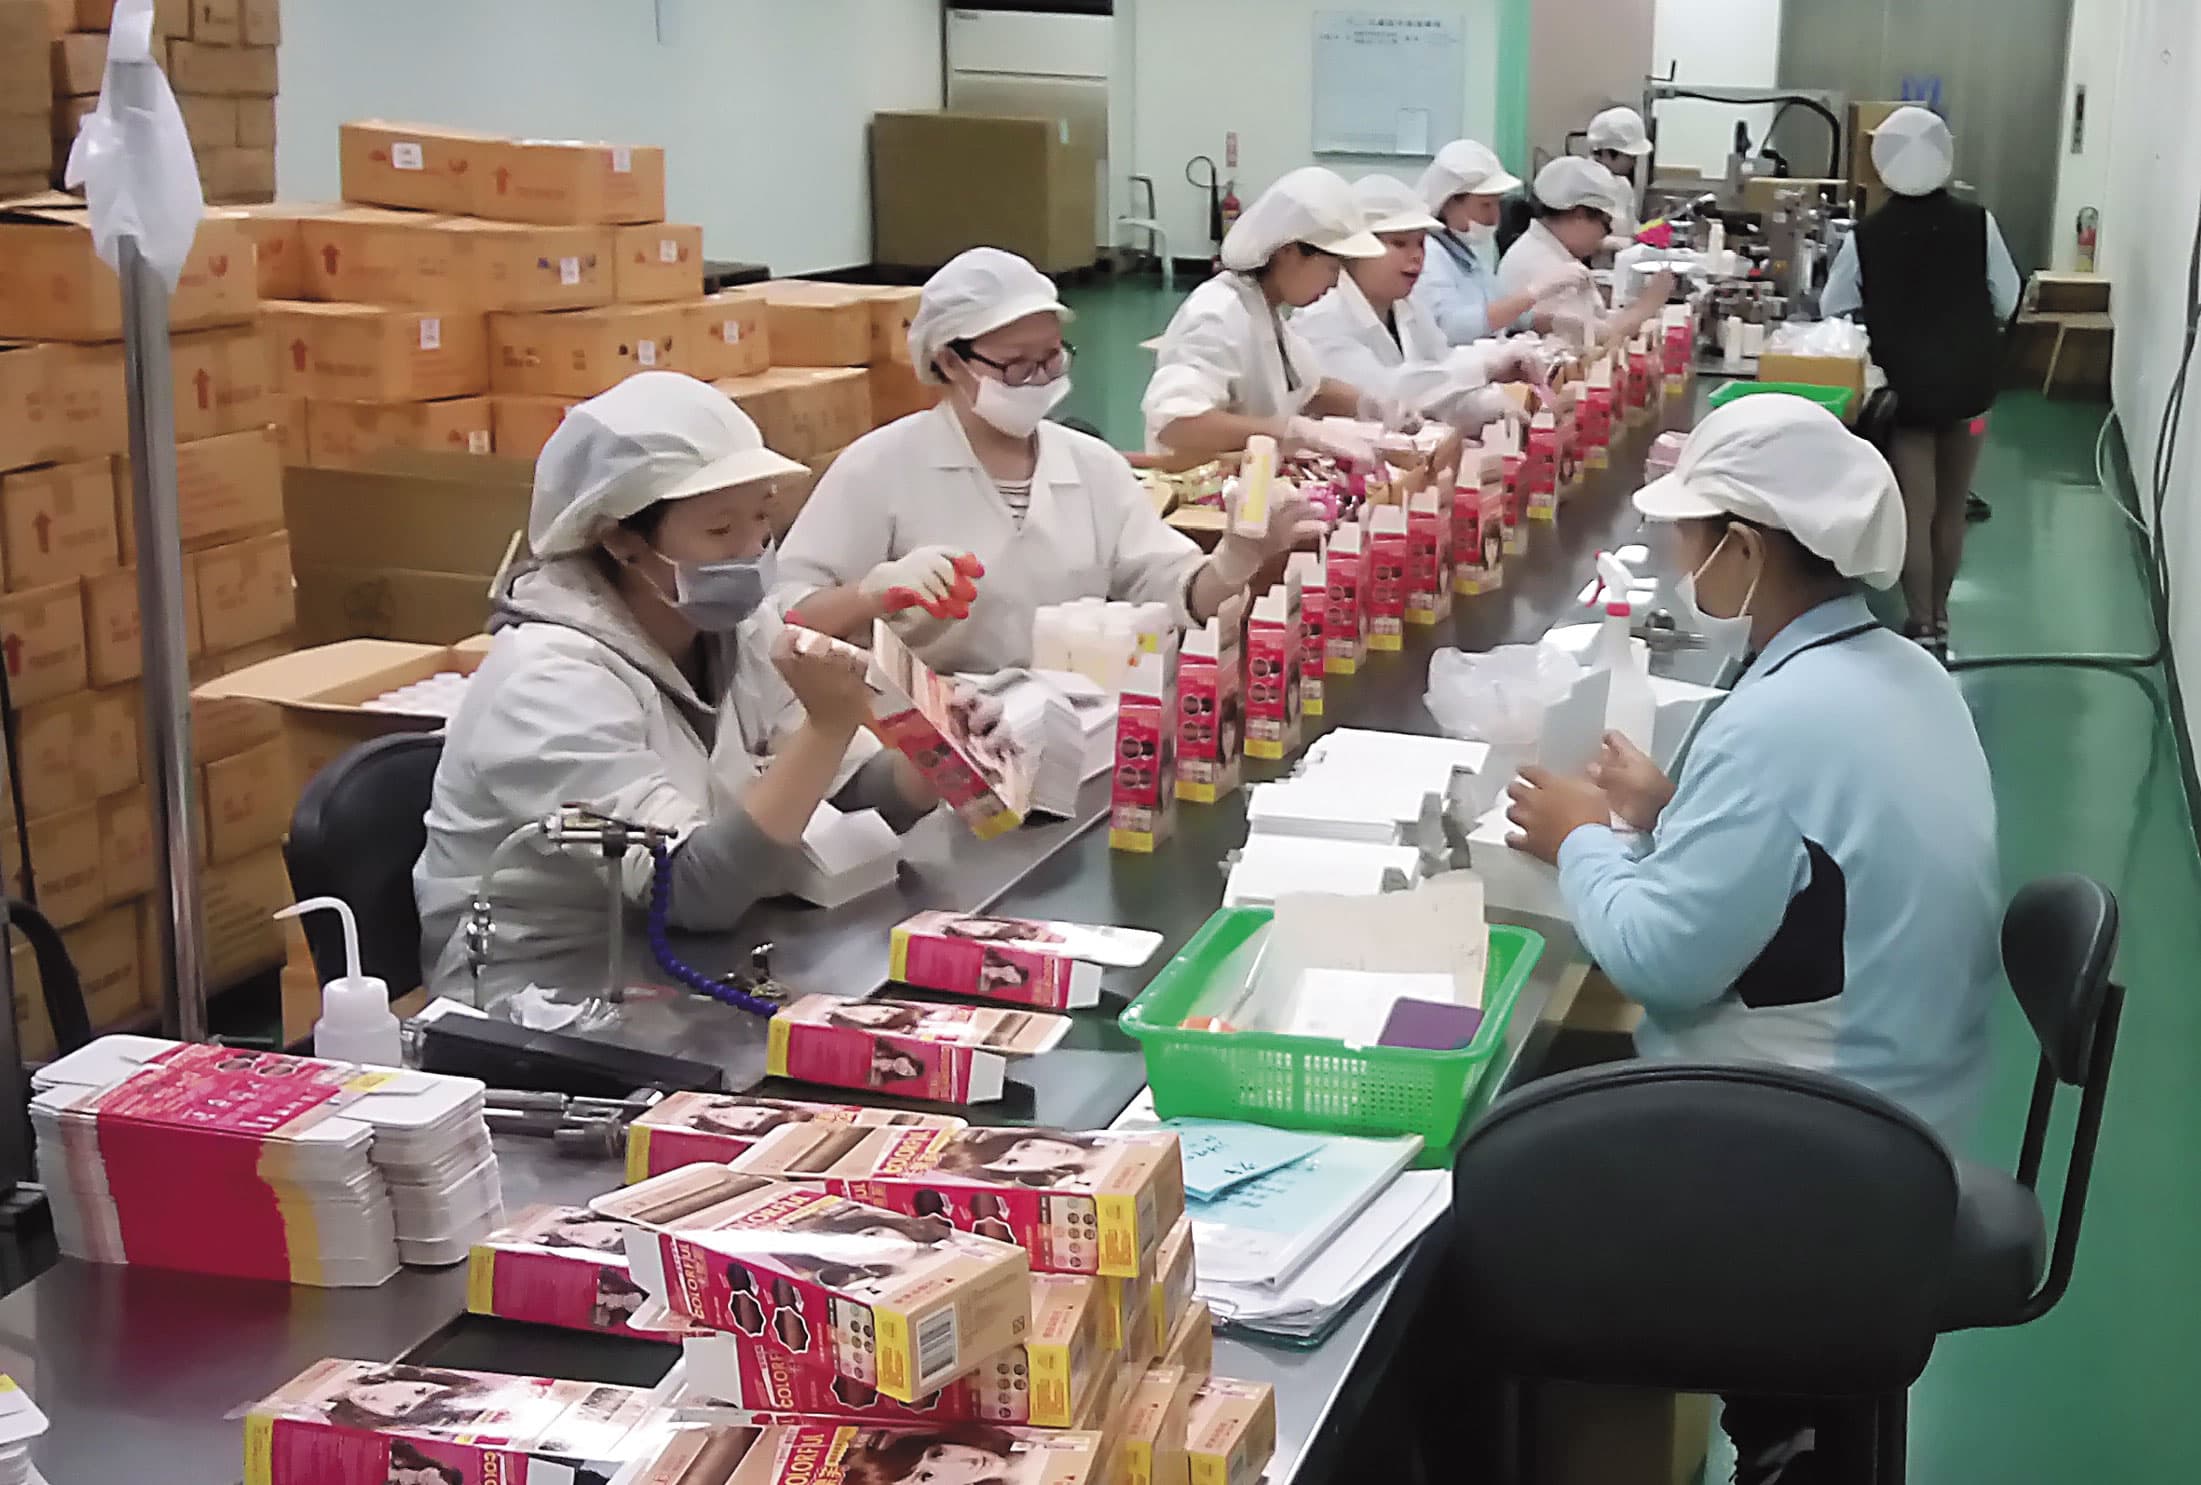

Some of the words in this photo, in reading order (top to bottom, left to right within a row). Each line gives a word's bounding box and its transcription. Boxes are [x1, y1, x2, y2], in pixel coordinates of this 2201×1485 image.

[677, 1242, 706, 1320] COLORFUL
[769, 1351, 795, 1410] COLORF
[785, 1433, 825, 1485] OLORFUL
